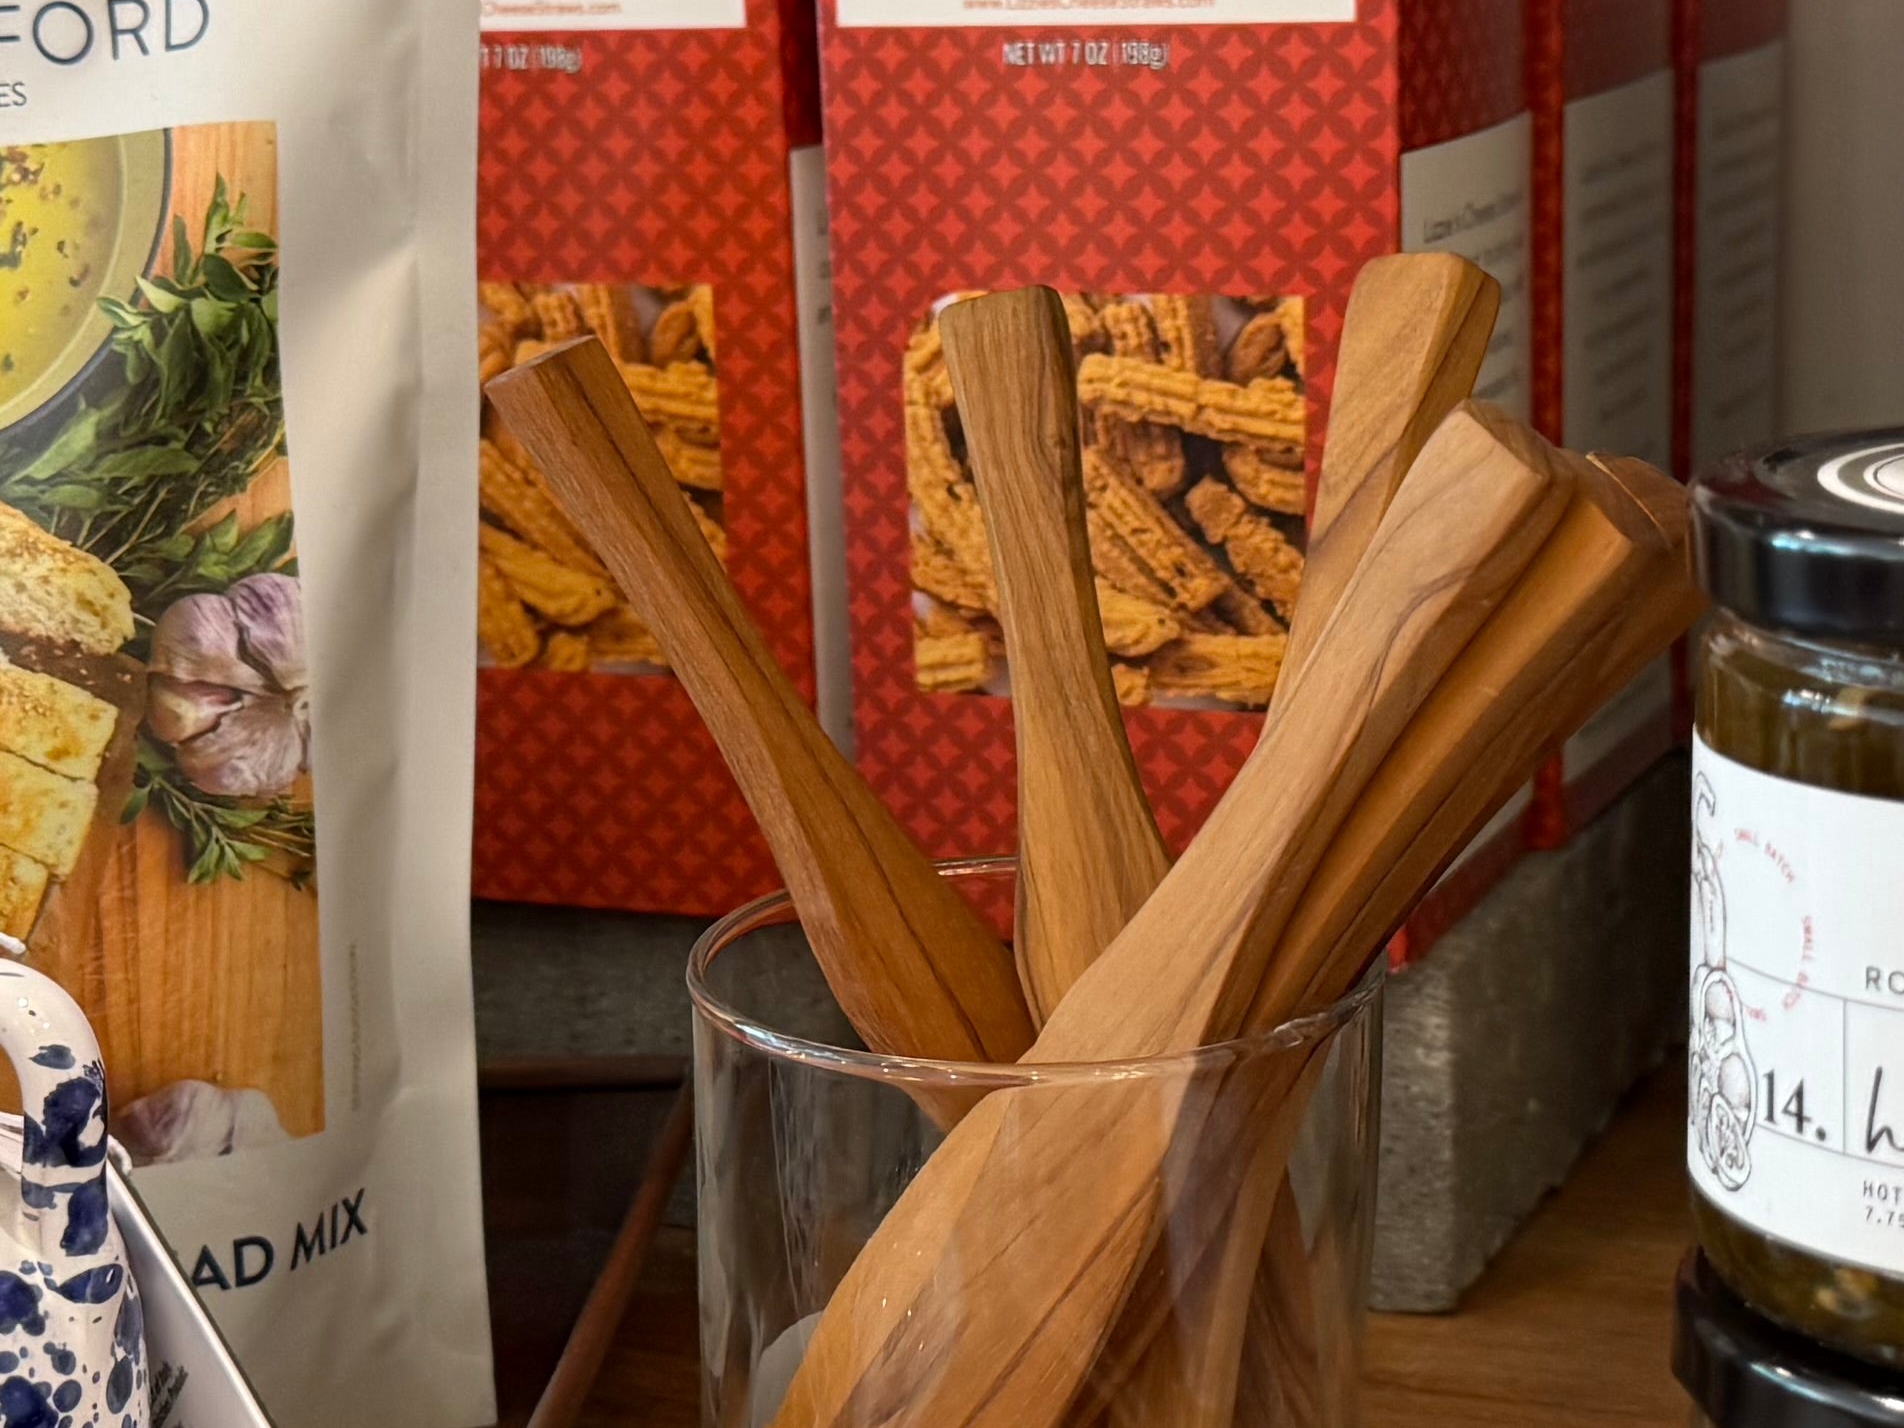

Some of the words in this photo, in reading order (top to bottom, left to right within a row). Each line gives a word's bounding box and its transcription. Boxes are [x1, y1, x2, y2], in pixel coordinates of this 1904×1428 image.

[1001, 42, 1035, 66] NET
[1862, 1179, 1904, 1206] HOT
[289, 1186, 370, 1274] MIX
